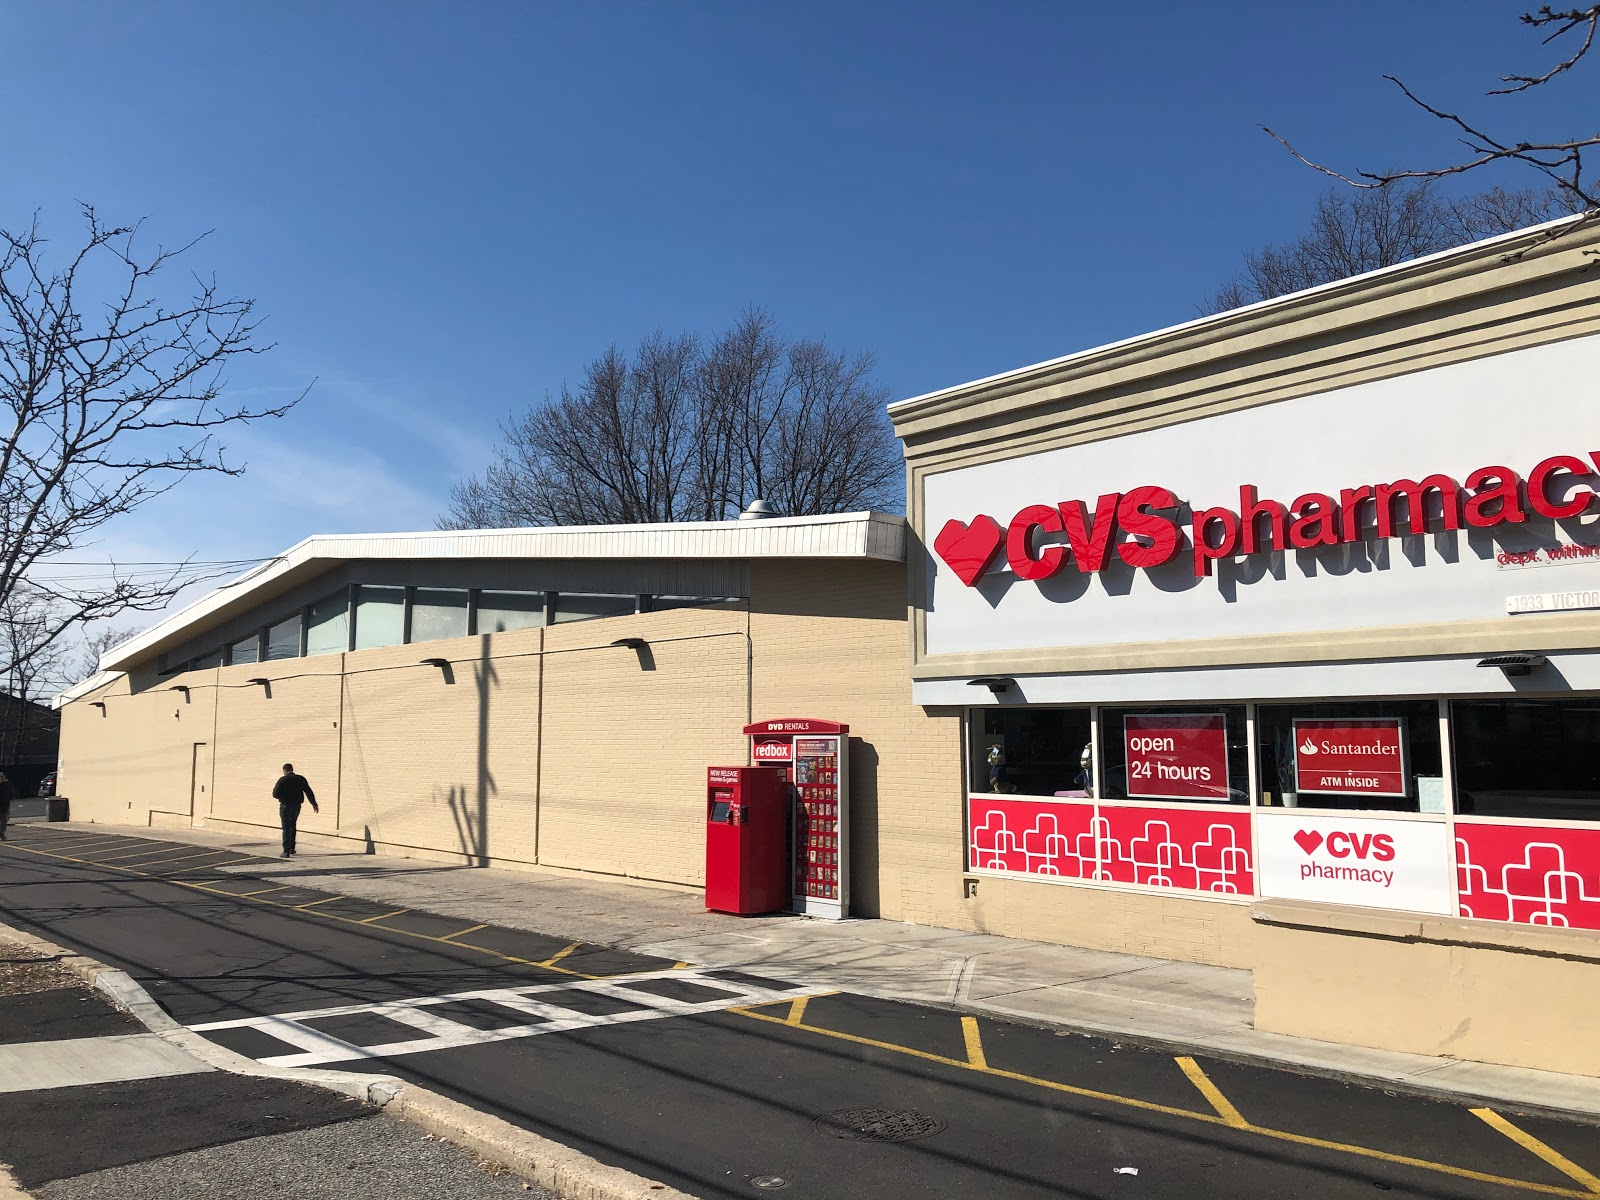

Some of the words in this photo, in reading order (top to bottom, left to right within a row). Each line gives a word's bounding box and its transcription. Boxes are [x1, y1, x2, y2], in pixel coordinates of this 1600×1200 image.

[1006, 485, 1182, 580] CVS
[1193, 451, 1600, 577] pharmac
[1546, 543, 1599, 560] within
[1514, 595, 1543, 611] 1933
[768, 723, 783, 731] DVD
[784, 722, 809, 730] RENTALS
[755, 743, 788, 757] redbox
[1130, 735, 1174, 755] open
[1321, 739, 1398, 755] Santander
[1131, 761, 1152, 779] 24
[1157, 761, 1211, 781] hours
[1320, 776, 1342, 787] ATM
[1344, 776, 1379, 788] INSIDE
[1326, 831, 1396, 862] CVS
[1300, 861, 1394, 887] pharmacy
